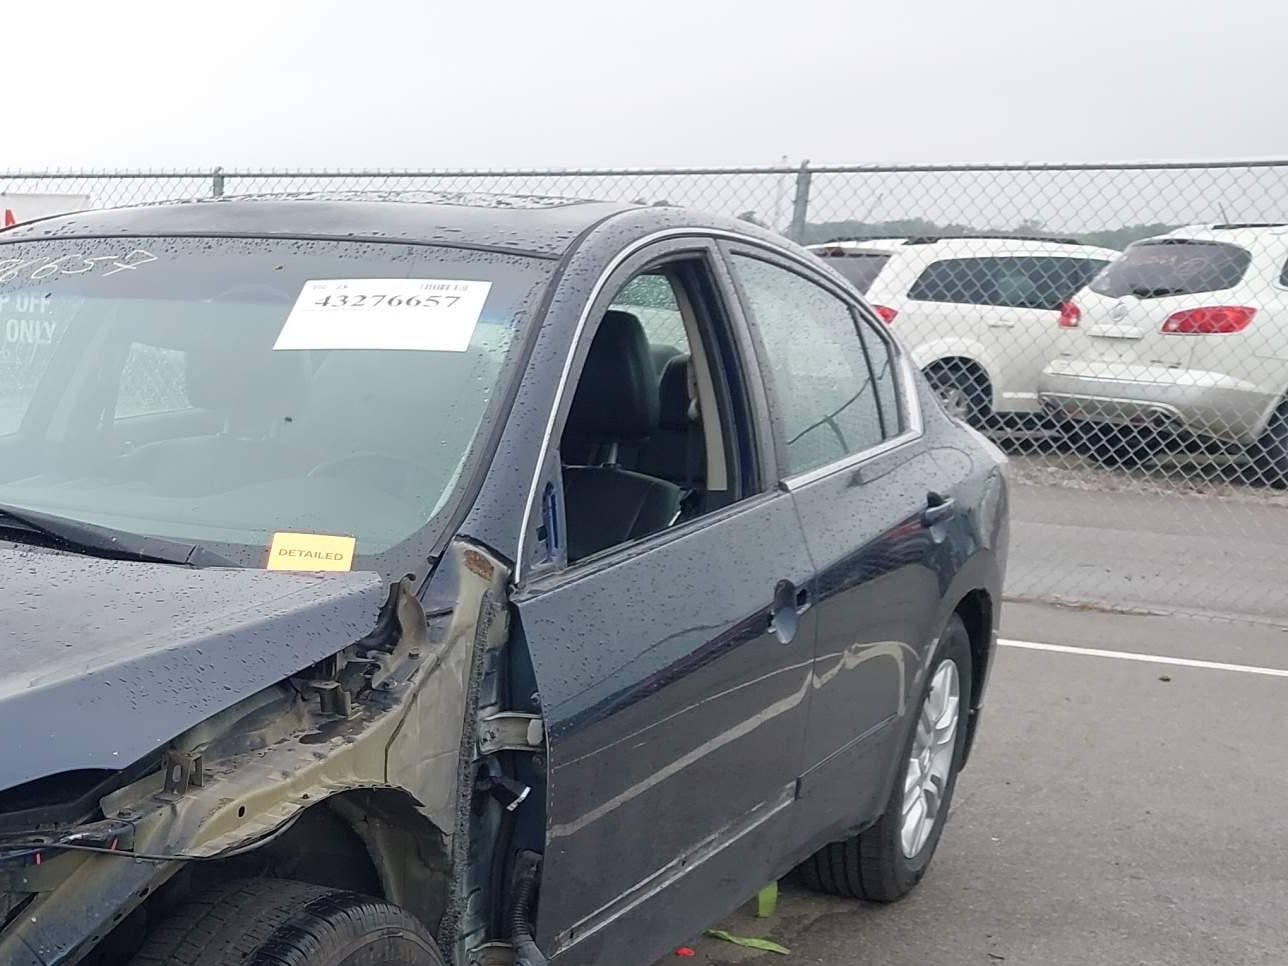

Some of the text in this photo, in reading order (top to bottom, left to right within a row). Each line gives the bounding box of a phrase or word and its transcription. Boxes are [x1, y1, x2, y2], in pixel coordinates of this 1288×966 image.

[313, 294, 462, 308] 43276657
[5, 318, 57, 345] ONLY
[278, 548, 344, 561] DETAILED
